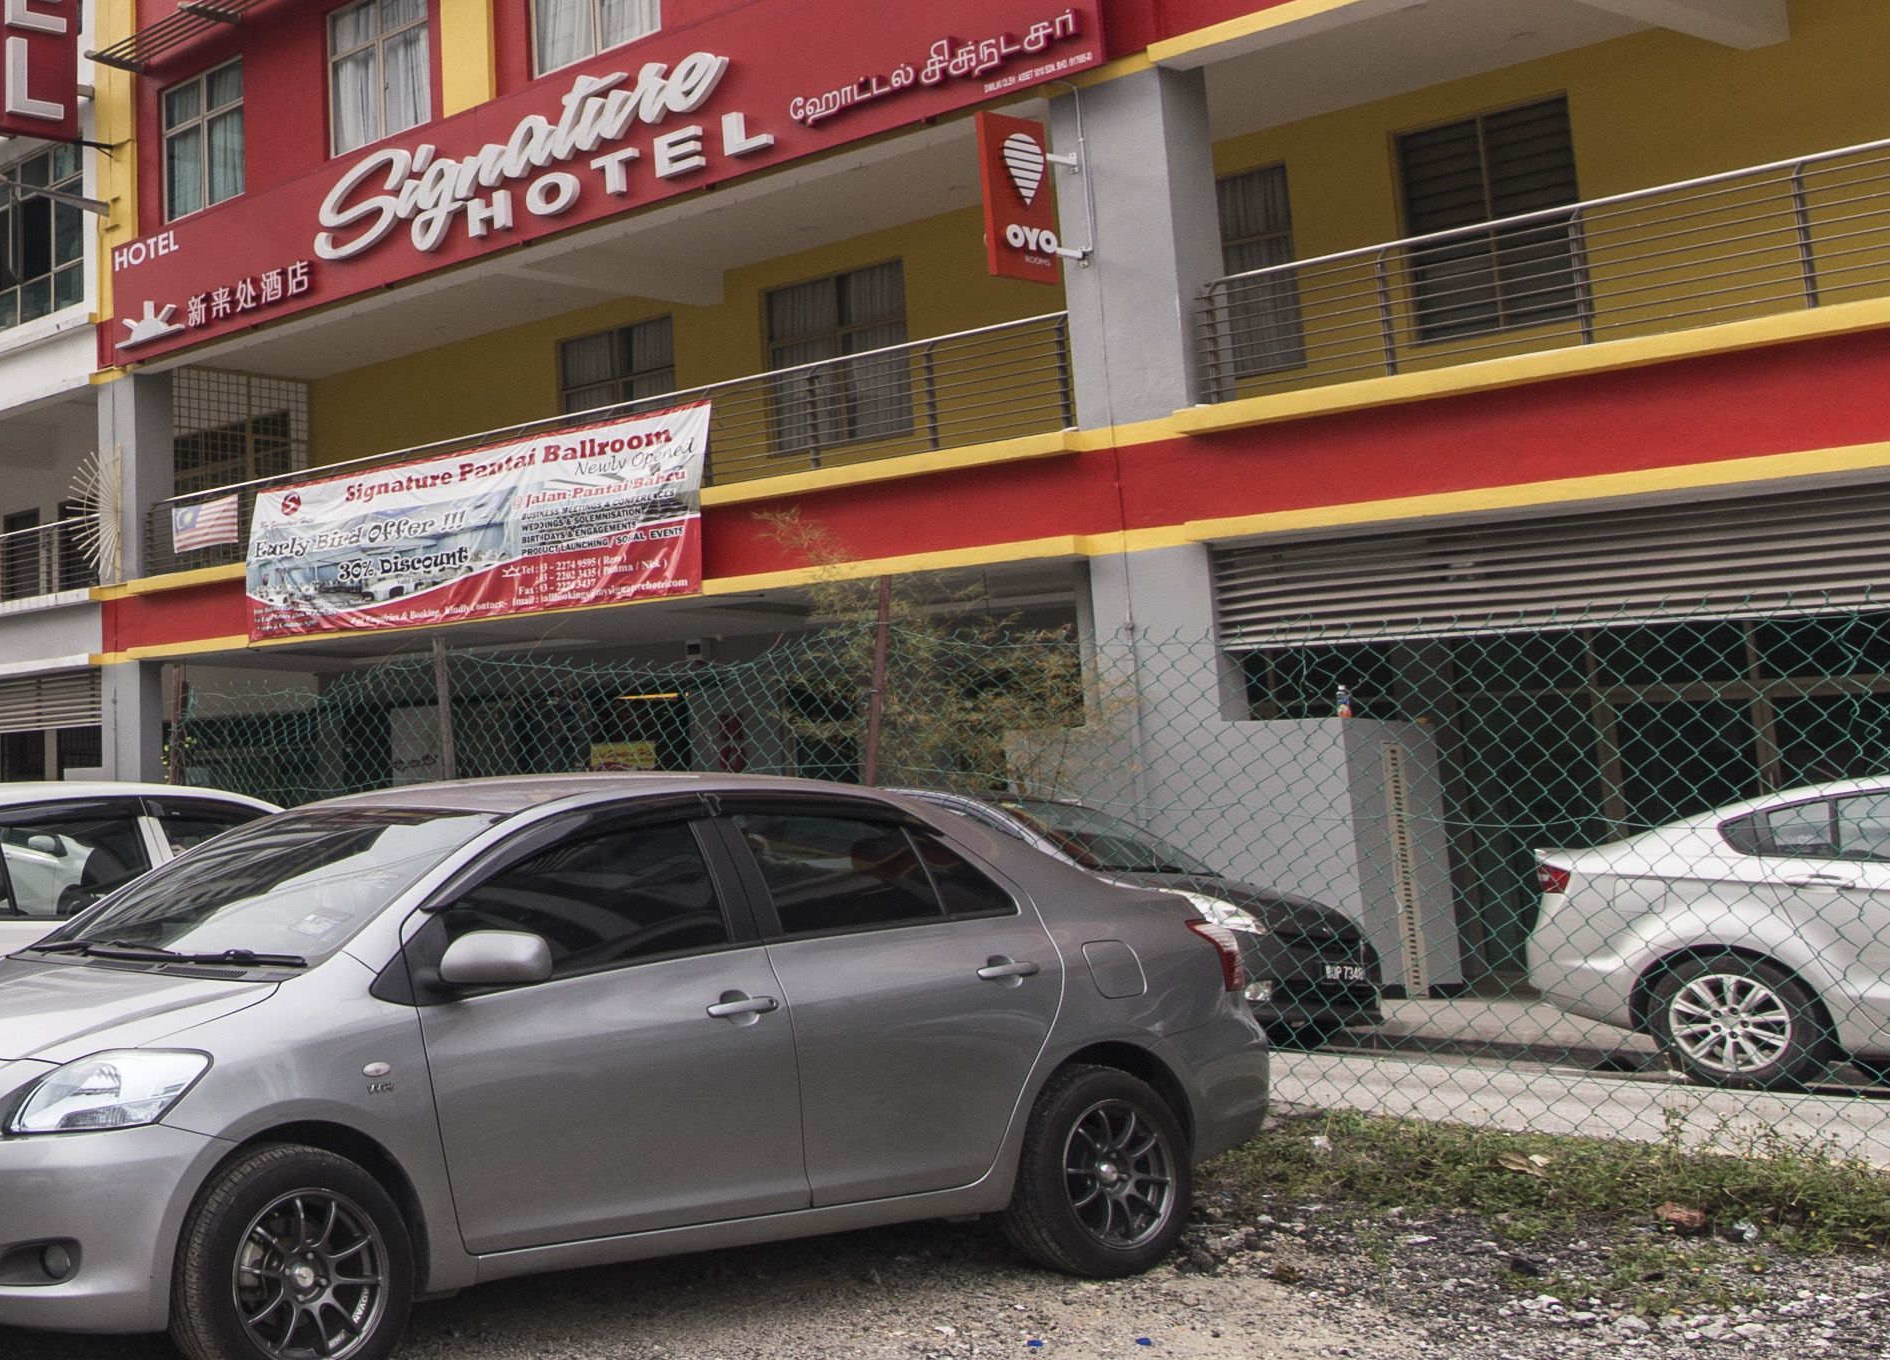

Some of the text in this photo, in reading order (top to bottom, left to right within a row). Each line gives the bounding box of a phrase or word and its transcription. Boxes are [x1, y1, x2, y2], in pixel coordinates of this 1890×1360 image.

[313, 51, 730, 262] Signature
[467, 111, 775, 238] HOTEL
[114, 230, 179, 272] HOTEL
[1005, 223, 1058, 254] OYO
[1024, 254, 1052, 267] ROOMS
[187, 260, 309, 328] 新来处酒店
[345, 428, 674, 503] Signature Pantai Ballroom
[574, 455, 626, 476] Newly
[525, 491, 567, 508] Jalan
[567, 481, 630, 499] Pantai
[521, 508, 559, 521] BUSINESS
[561, 502, 602, 515] MEETINGS
[573, 507, 641, 525] SOLEMNISATION
[254, 508, 466, 559] Early Bird Offer !!!
[560, 538, 608, 553] LAUNCHING
[616, 532, 645, 545] SOAL
[650, 526, 685, 540] EVENTS
[574, 521, 637, 537] ENGAGEMENTS
[338, 561, 375, 580] 30%
[380, 545, 469, 574] Discount
